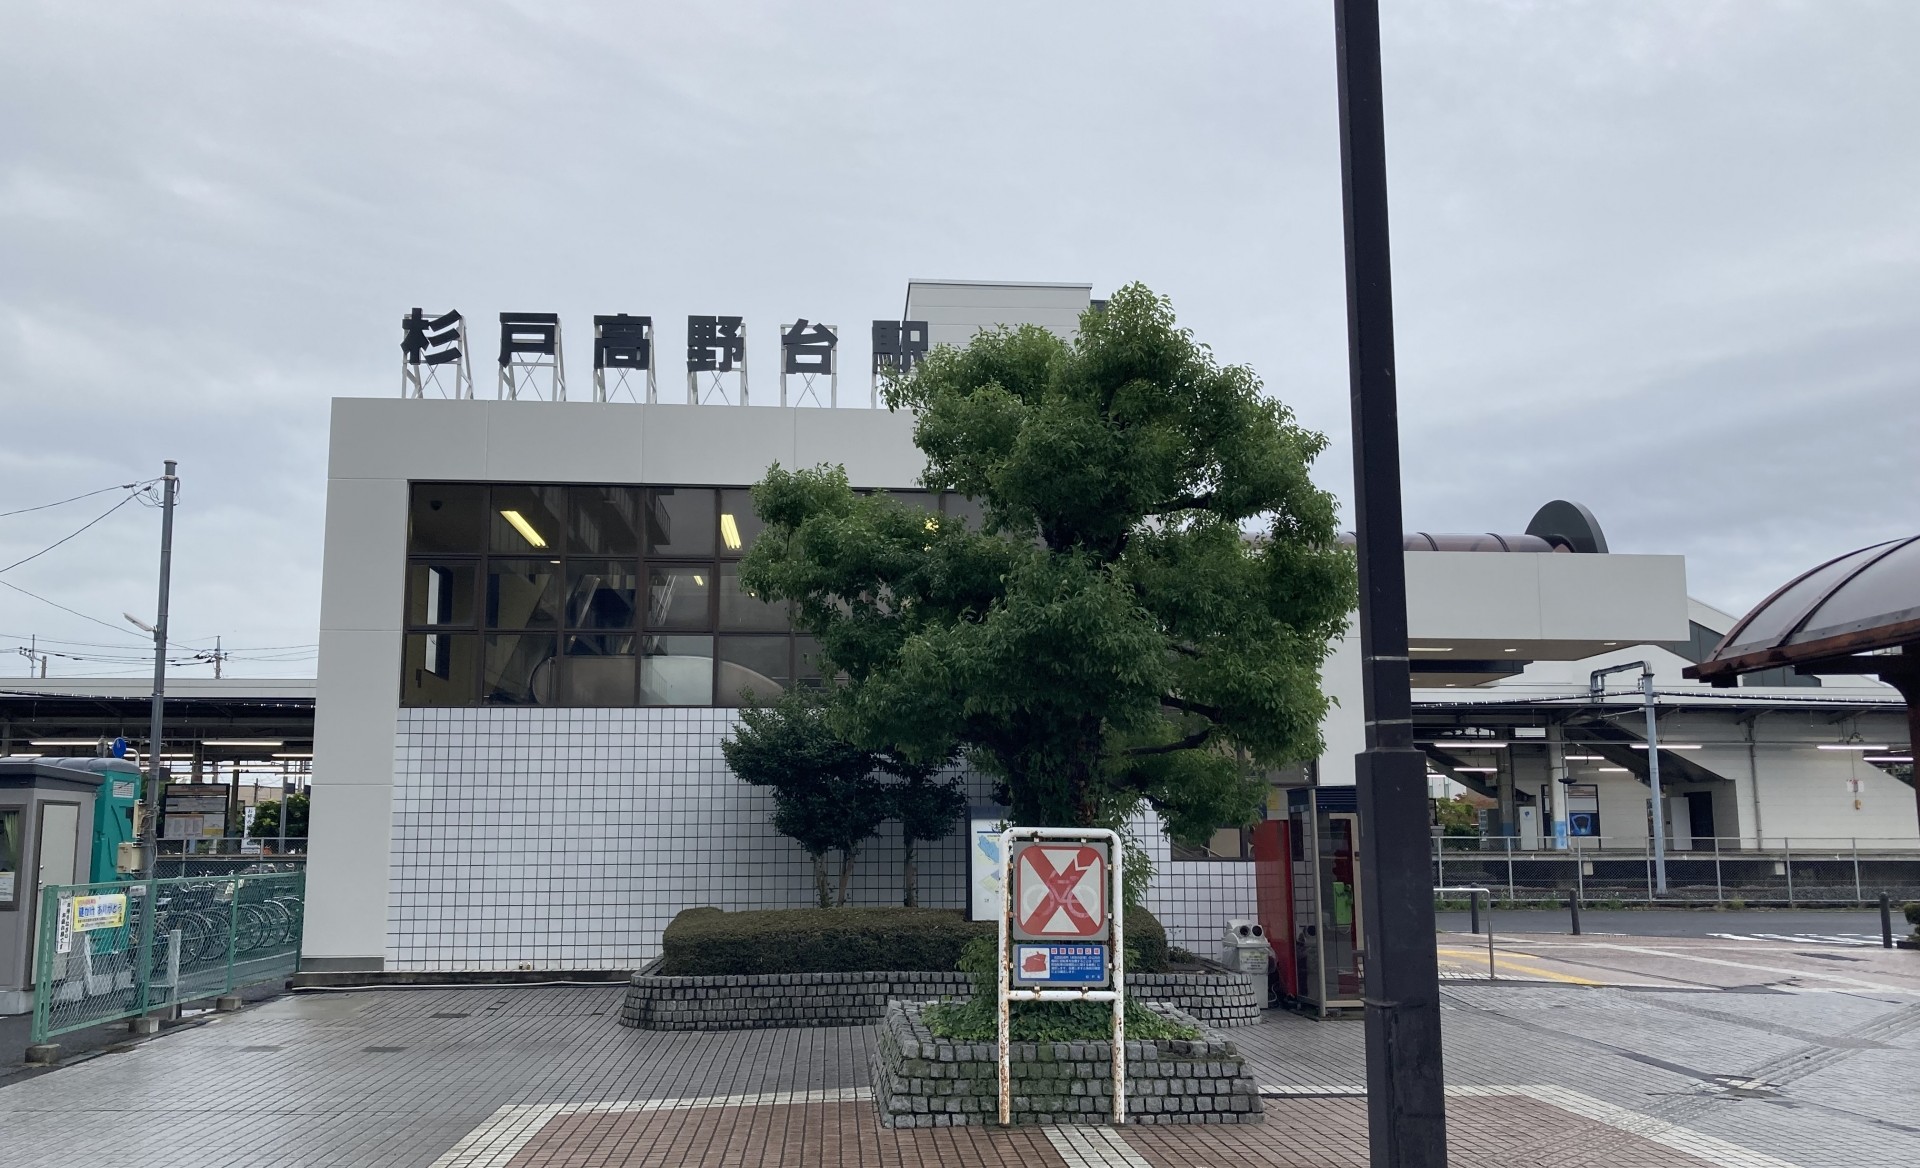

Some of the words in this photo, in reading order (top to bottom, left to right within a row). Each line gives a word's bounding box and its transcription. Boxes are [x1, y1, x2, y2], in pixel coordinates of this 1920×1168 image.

[400, 307, 929, 374] 杉戸高野台駅
